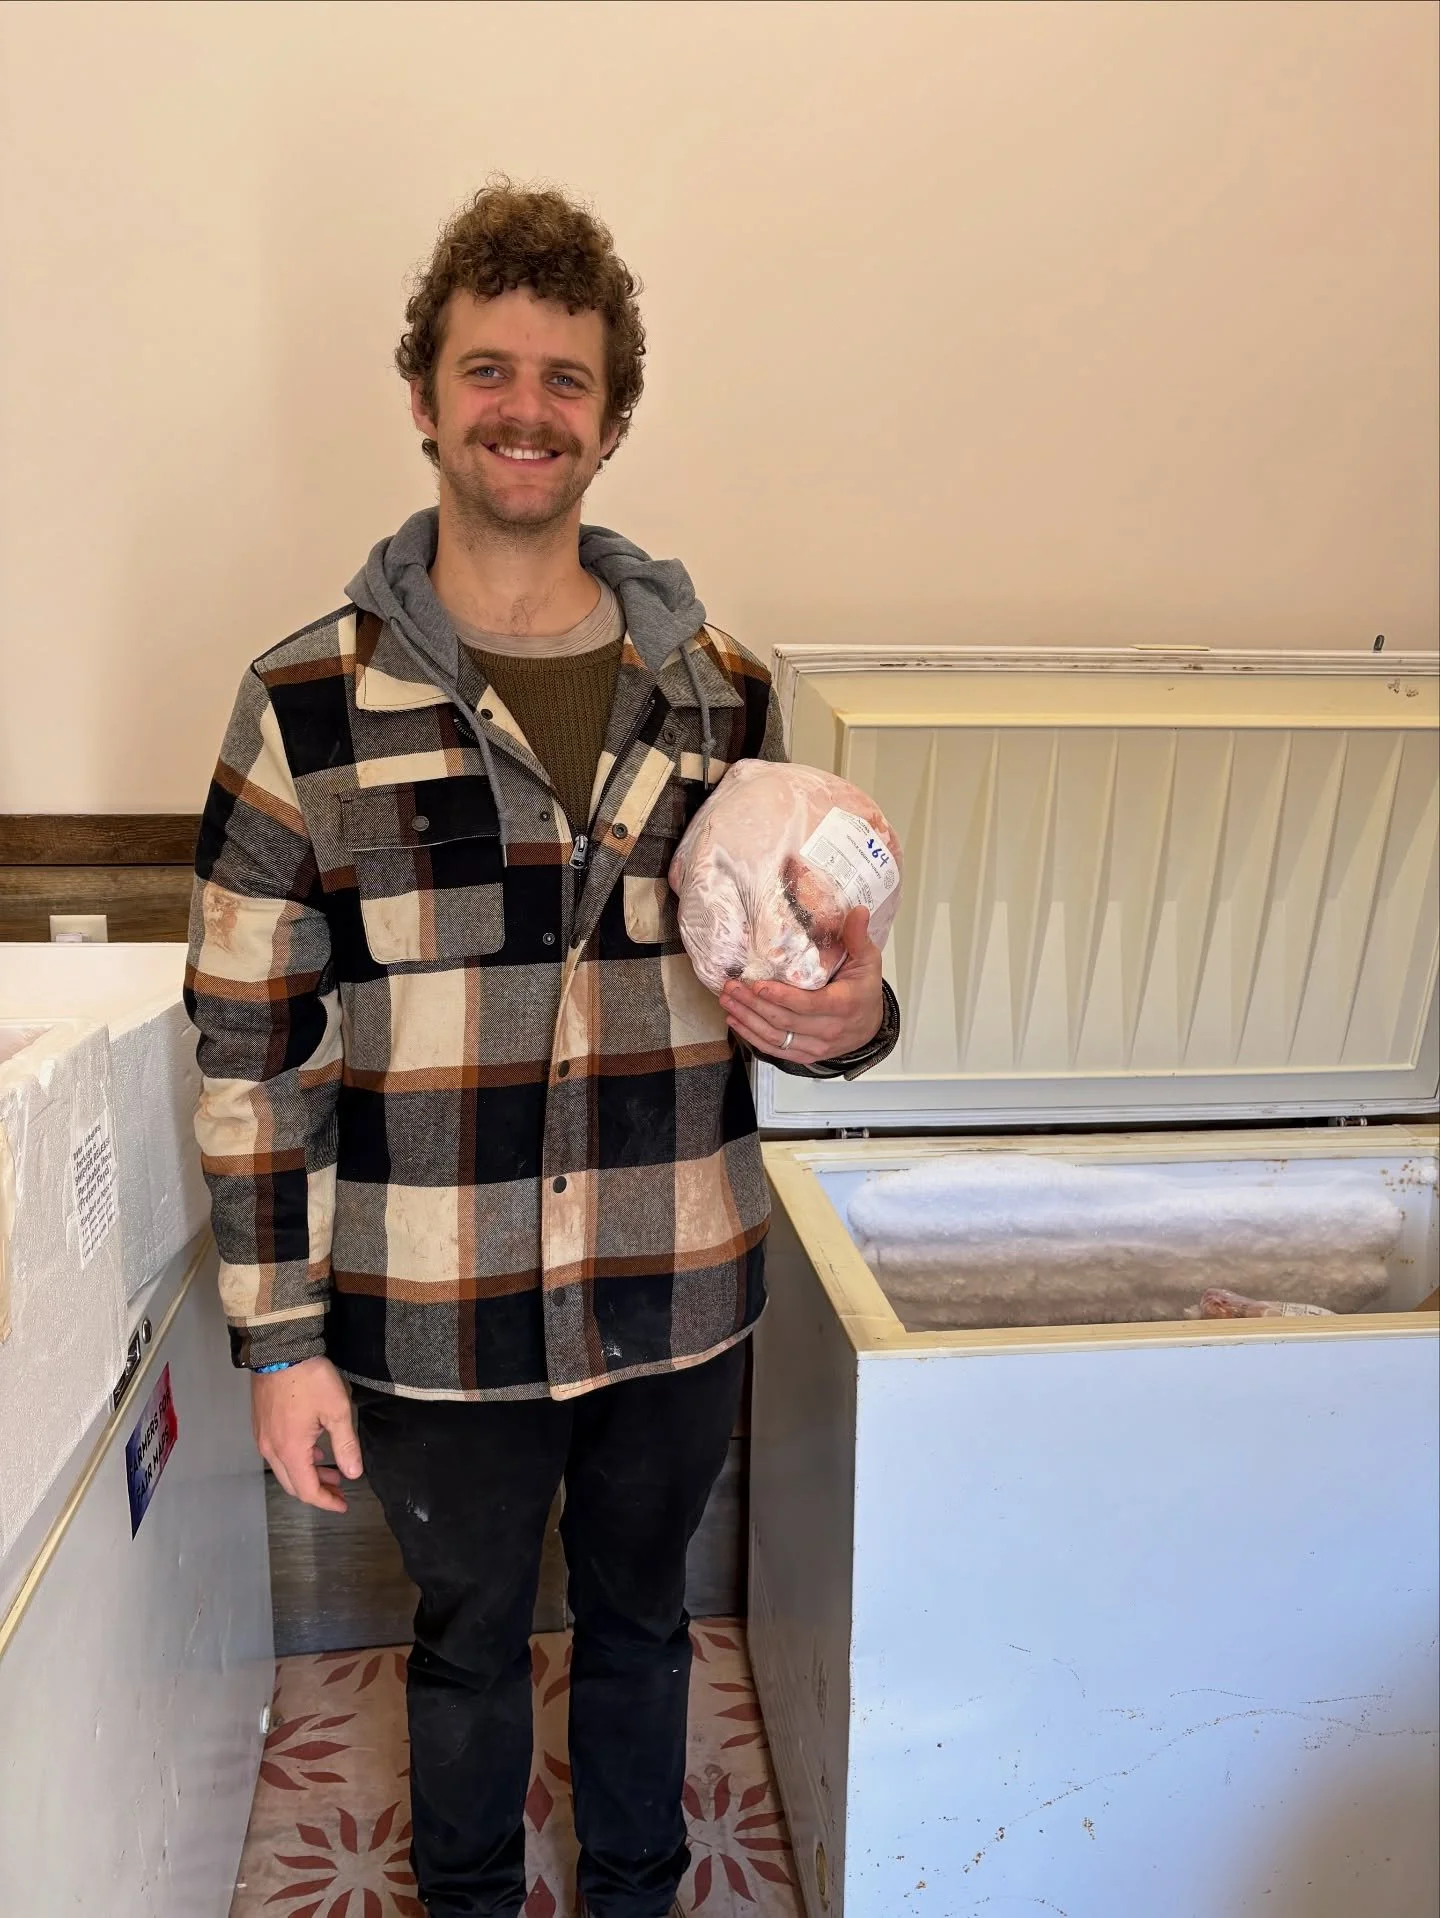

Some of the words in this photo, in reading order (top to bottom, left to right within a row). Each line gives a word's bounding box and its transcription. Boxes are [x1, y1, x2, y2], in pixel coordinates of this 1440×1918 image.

[129, 1412, 159, 1478] FARMERS
[158, 1386, 171, 1421] FOR
[136, 1462, 153, 1502] FAIR
[152, 1423, 170, 1470] MAPS
